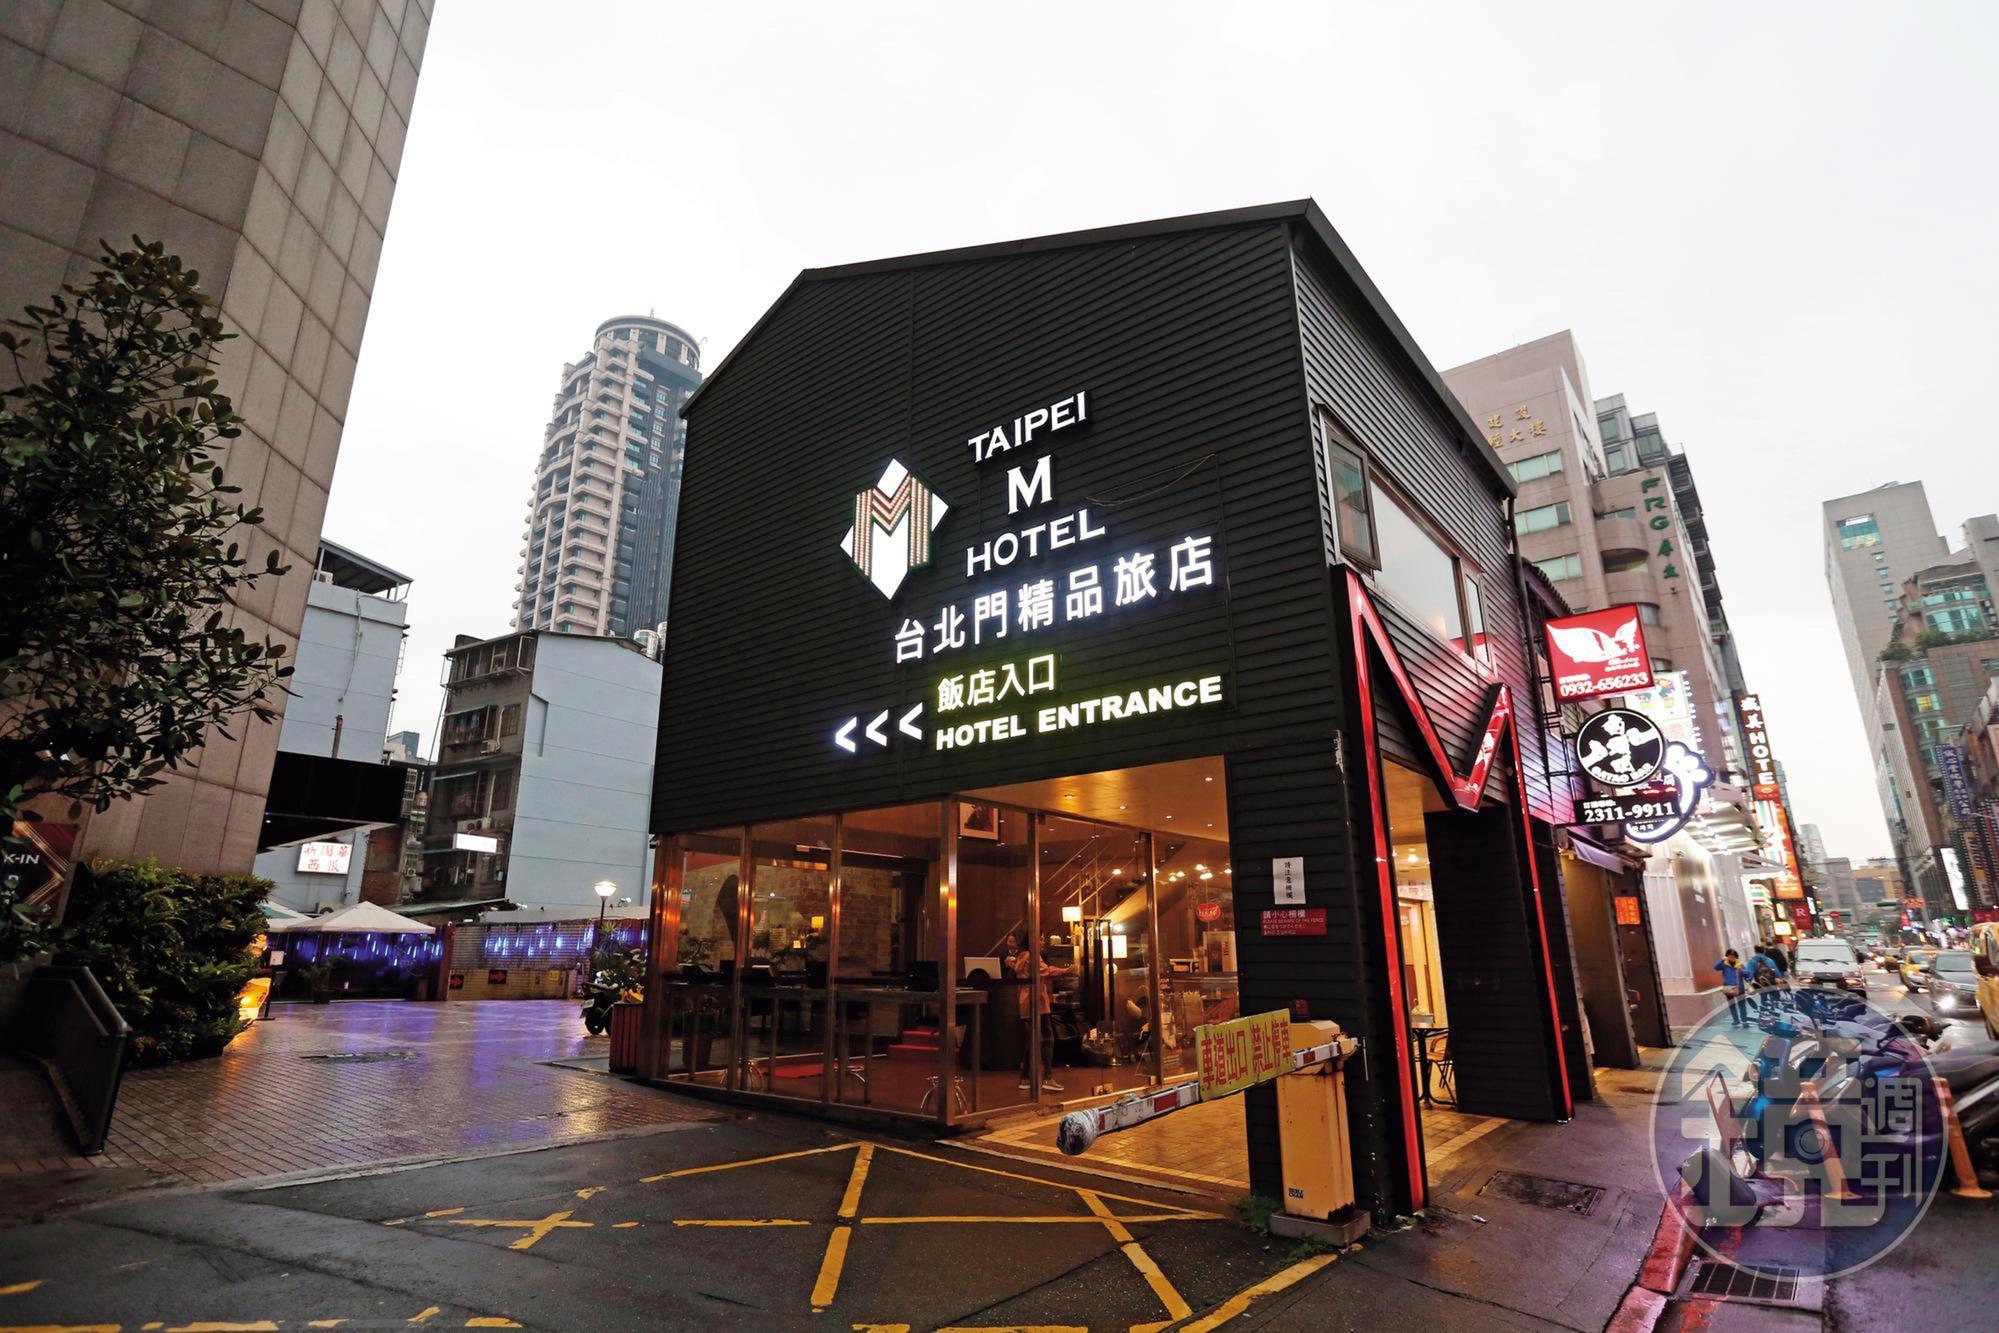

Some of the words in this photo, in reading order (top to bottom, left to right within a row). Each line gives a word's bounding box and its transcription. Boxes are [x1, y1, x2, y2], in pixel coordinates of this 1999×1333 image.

[968, 391, 1088, 463] TAIPEI
[1007, 455, 1053, 515] M
[966, 509, 1106, 577] HOTEL
[894, 535, 1214, 664] 台北門精品旅店
[936, 714, 1027, 751] HOTEL
[1038, 675, 1223, 734] ENTRANCE
[937, 653, 1056, 714] 飯店入口
[1560, 671, 1649, 697] 0932-656233
[1584, 801, 1675, 823] 2311-9911
[1201, 1029, 1248, 1090] 車道出口
[1252, 1017, 1291, 1073] 禁止停車
